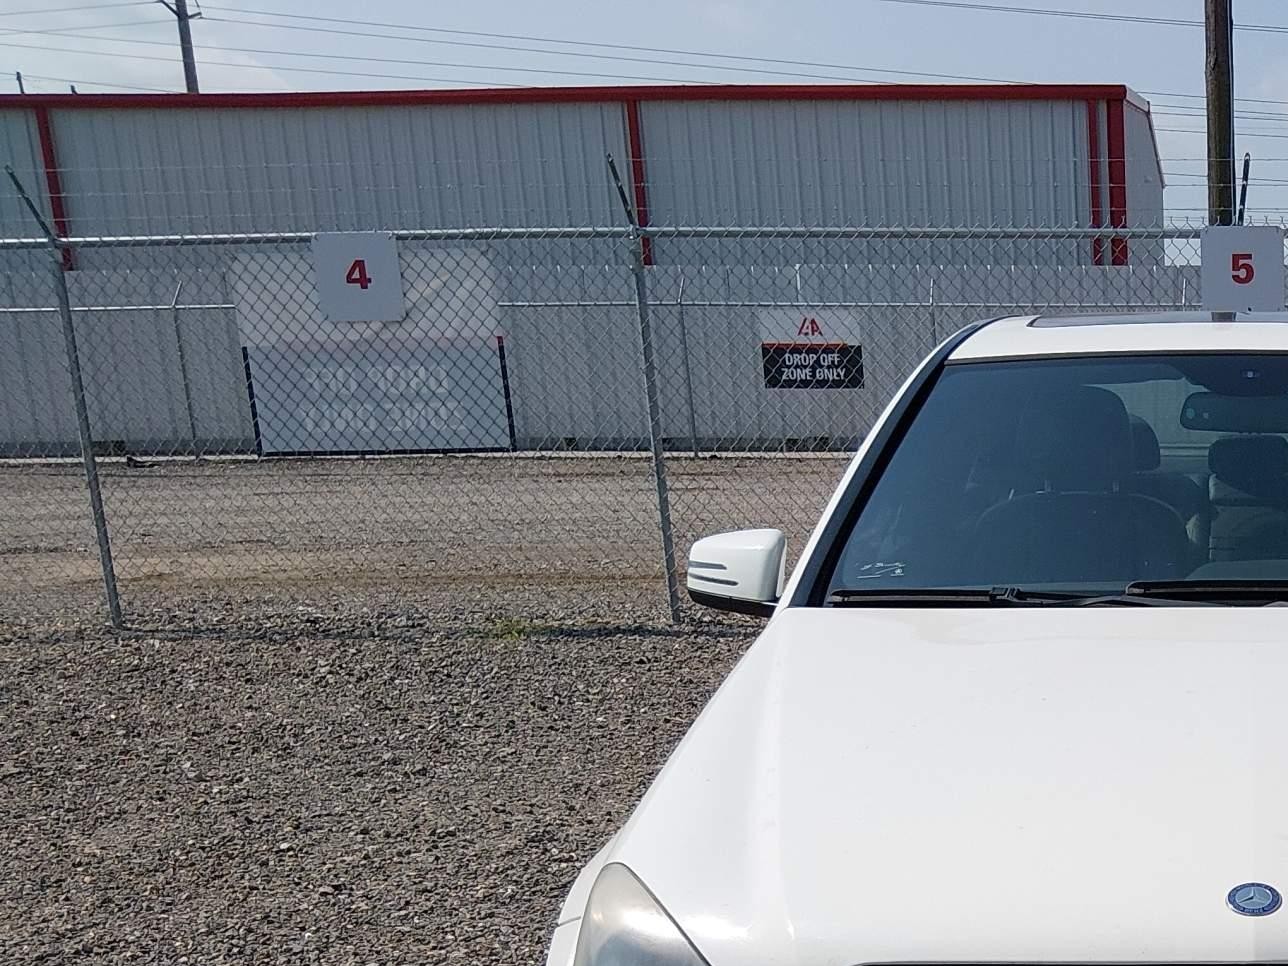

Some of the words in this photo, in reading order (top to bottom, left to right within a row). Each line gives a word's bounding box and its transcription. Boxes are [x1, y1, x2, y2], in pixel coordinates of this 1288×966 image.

[346, 259, 372, 290] 4
[1231, 253, 1255, 285] 5
[784, 353, 817, 366] DROP
[820, 353, 841, 366] OFF
[781, 367, 813, 380] ZONE
[815, 367, 846, 380] ONLY
